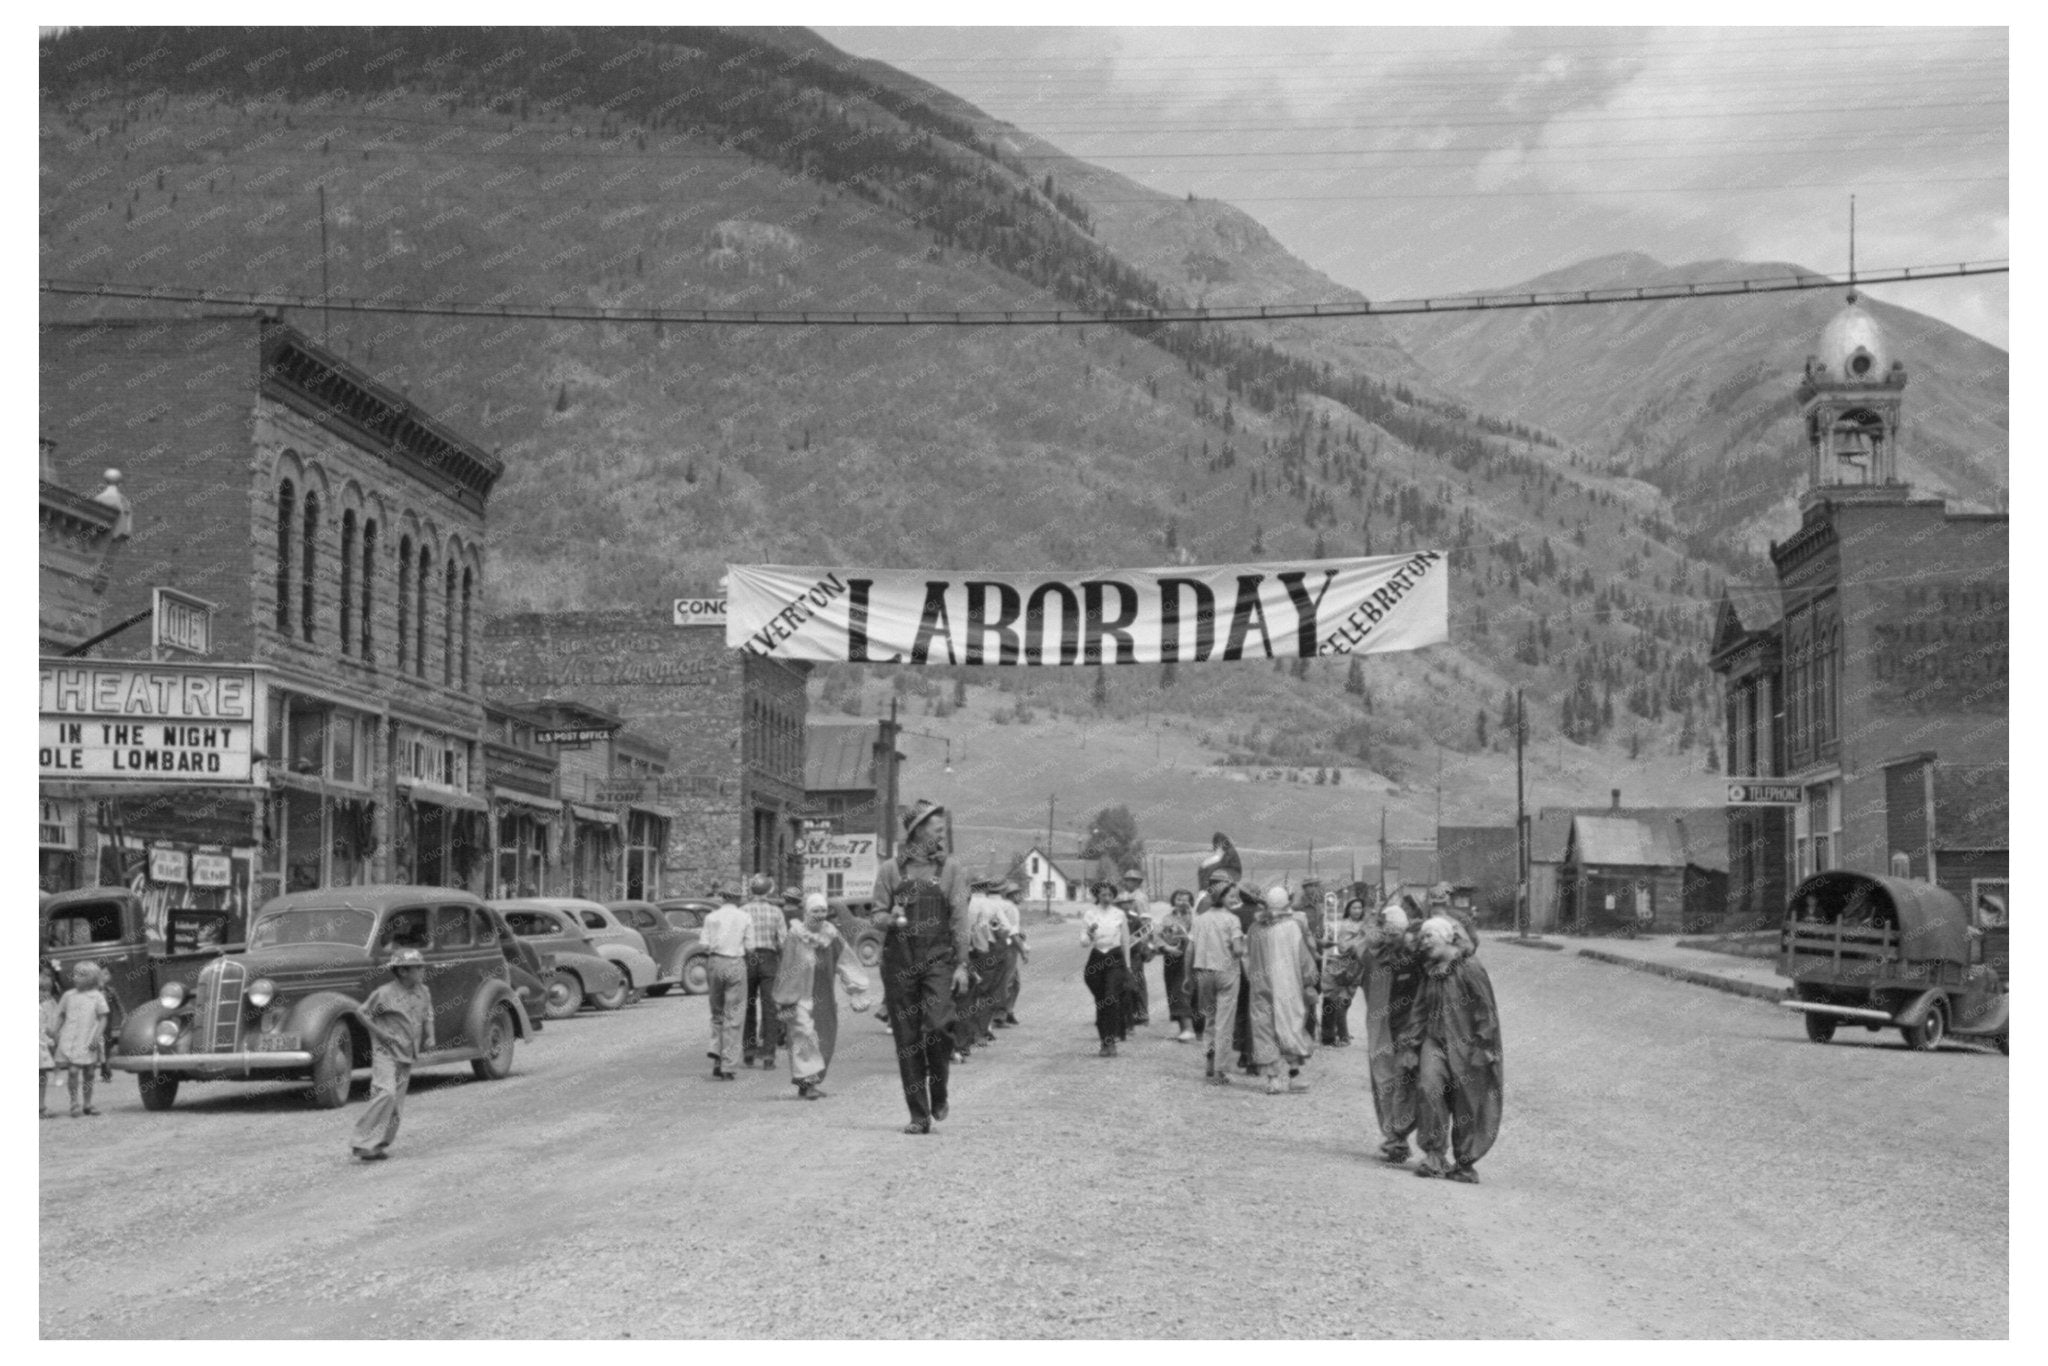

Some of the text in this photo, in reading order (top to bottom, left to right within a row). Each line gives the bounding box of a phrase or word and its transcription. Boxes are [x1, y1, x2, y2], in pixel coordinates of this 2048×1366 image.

[738, 572, 846, 657] LVERTON
[847, 568, 1339, 666] LABOR DAY
[60, 723, 232, 749] IN THE NIGHT
[554, 731, 577, 741] POST
[39, 747, 221, 772] OLE LOMBARD
[398, 738, 462, 787] HADWAE
[595, 792, 643, 803] STORE
[1750, 786, 1800, 801] TELEPHONE
[848, 840, 873, 854] 77
